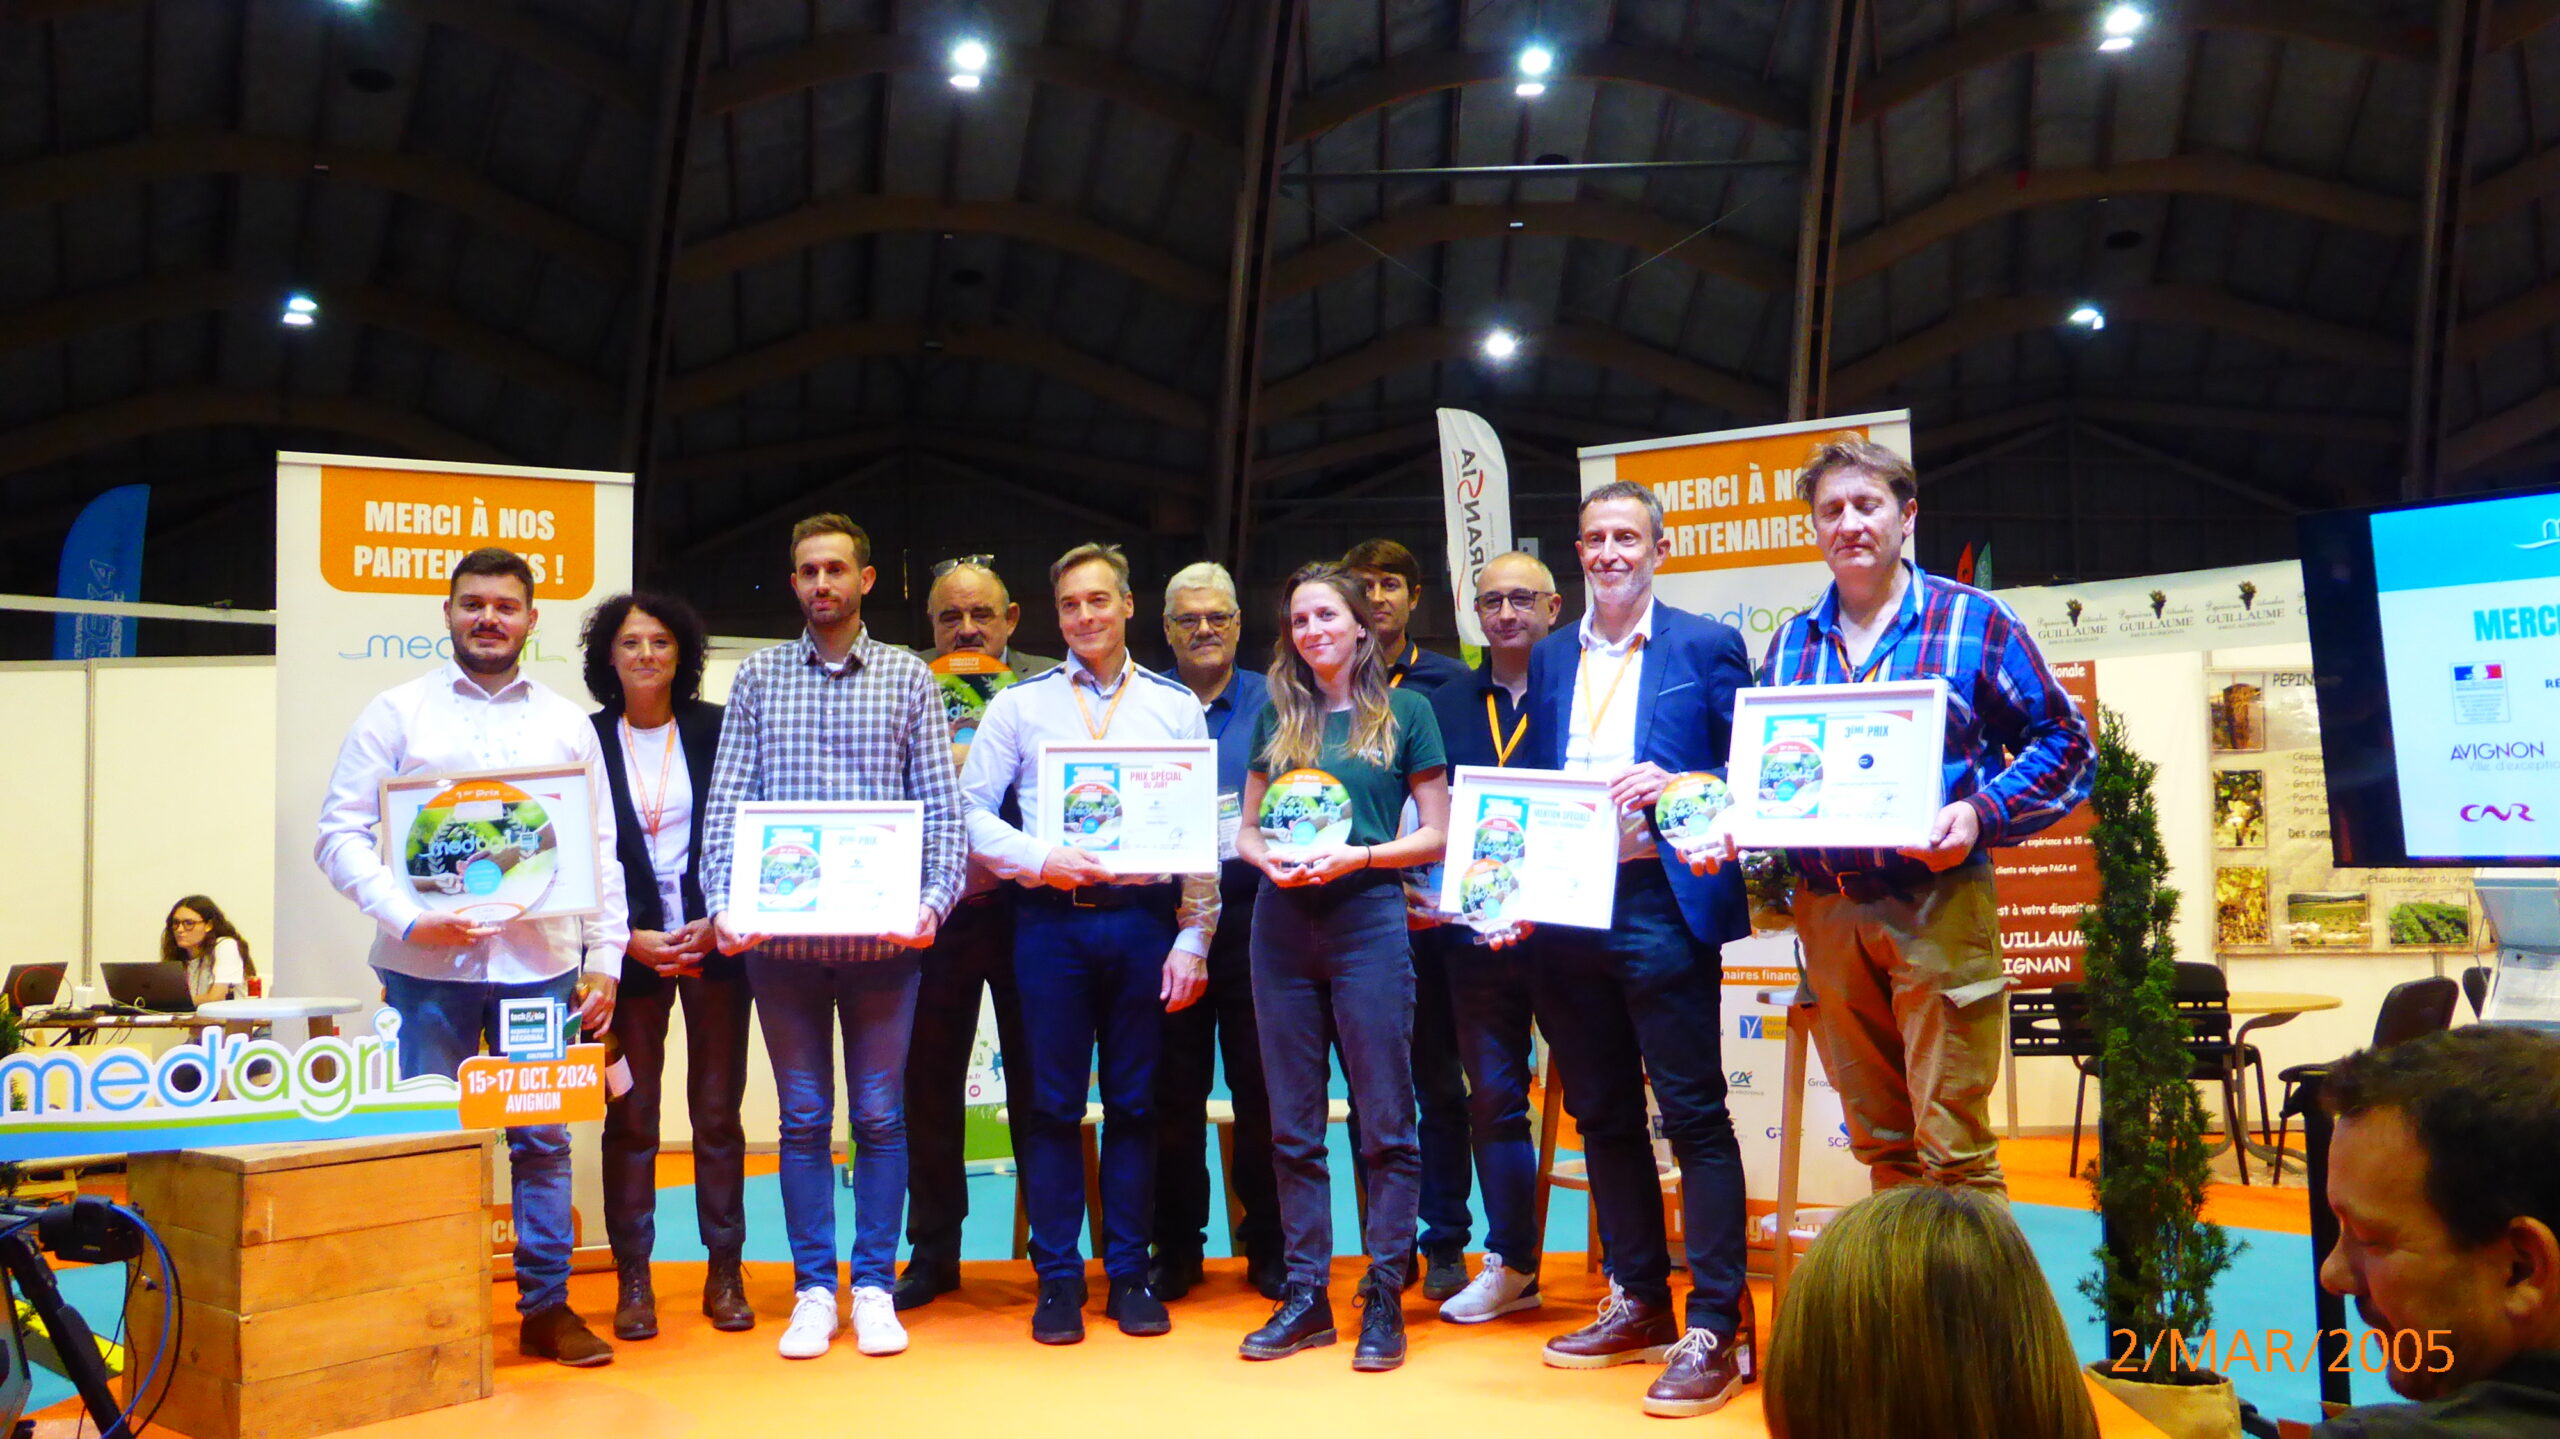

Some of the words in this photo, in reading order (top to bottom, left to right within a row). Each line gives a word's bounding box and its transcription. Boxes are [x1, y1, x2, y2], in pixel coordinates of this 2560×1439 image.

[1653, 474, 1739, 512] MERCI
[1748, 462, 1766, 504] À
[365, 500, 461, 536] MERCI
[470, 496, 489, 537] À
[498, 507, 555, 540] NOS
[1664, 512, 1817, 558] ARTENAIRES
[354, 545, 546, 584] PARTENS
[2206, 608, 2284, 624] GUILLAUME
[2119, 617, 2194, 632] GUILLAUME
[2038, 625, 2108, 639] GUILLAUME
[2273, 673, 2314, 687] PEPIN
[1867, 725, 1889, 737] PRIX
[2293, 752, 2323, 763] Cépag
[2451, 741, 2544, 760] AVIGNON
[1130, 771, 1147, 782] PRIX
[2293, 766, 2325, 777] Cépag
[2288, 828, 2306, 839] Des
[2049, 864, 2067, 872] PACA
[2012, 903, 2018, 916] à
[2021, 904, 2046, 915] votre
[2002, 956, 2071, 974] IGNAN
[1723, 970, 1760, 981] naires
[519, 1066, 552, 1091] OCT.
[557, 1064, 598, 1088] 2024
[506, 1092, 561, 1113] AVIGNON
